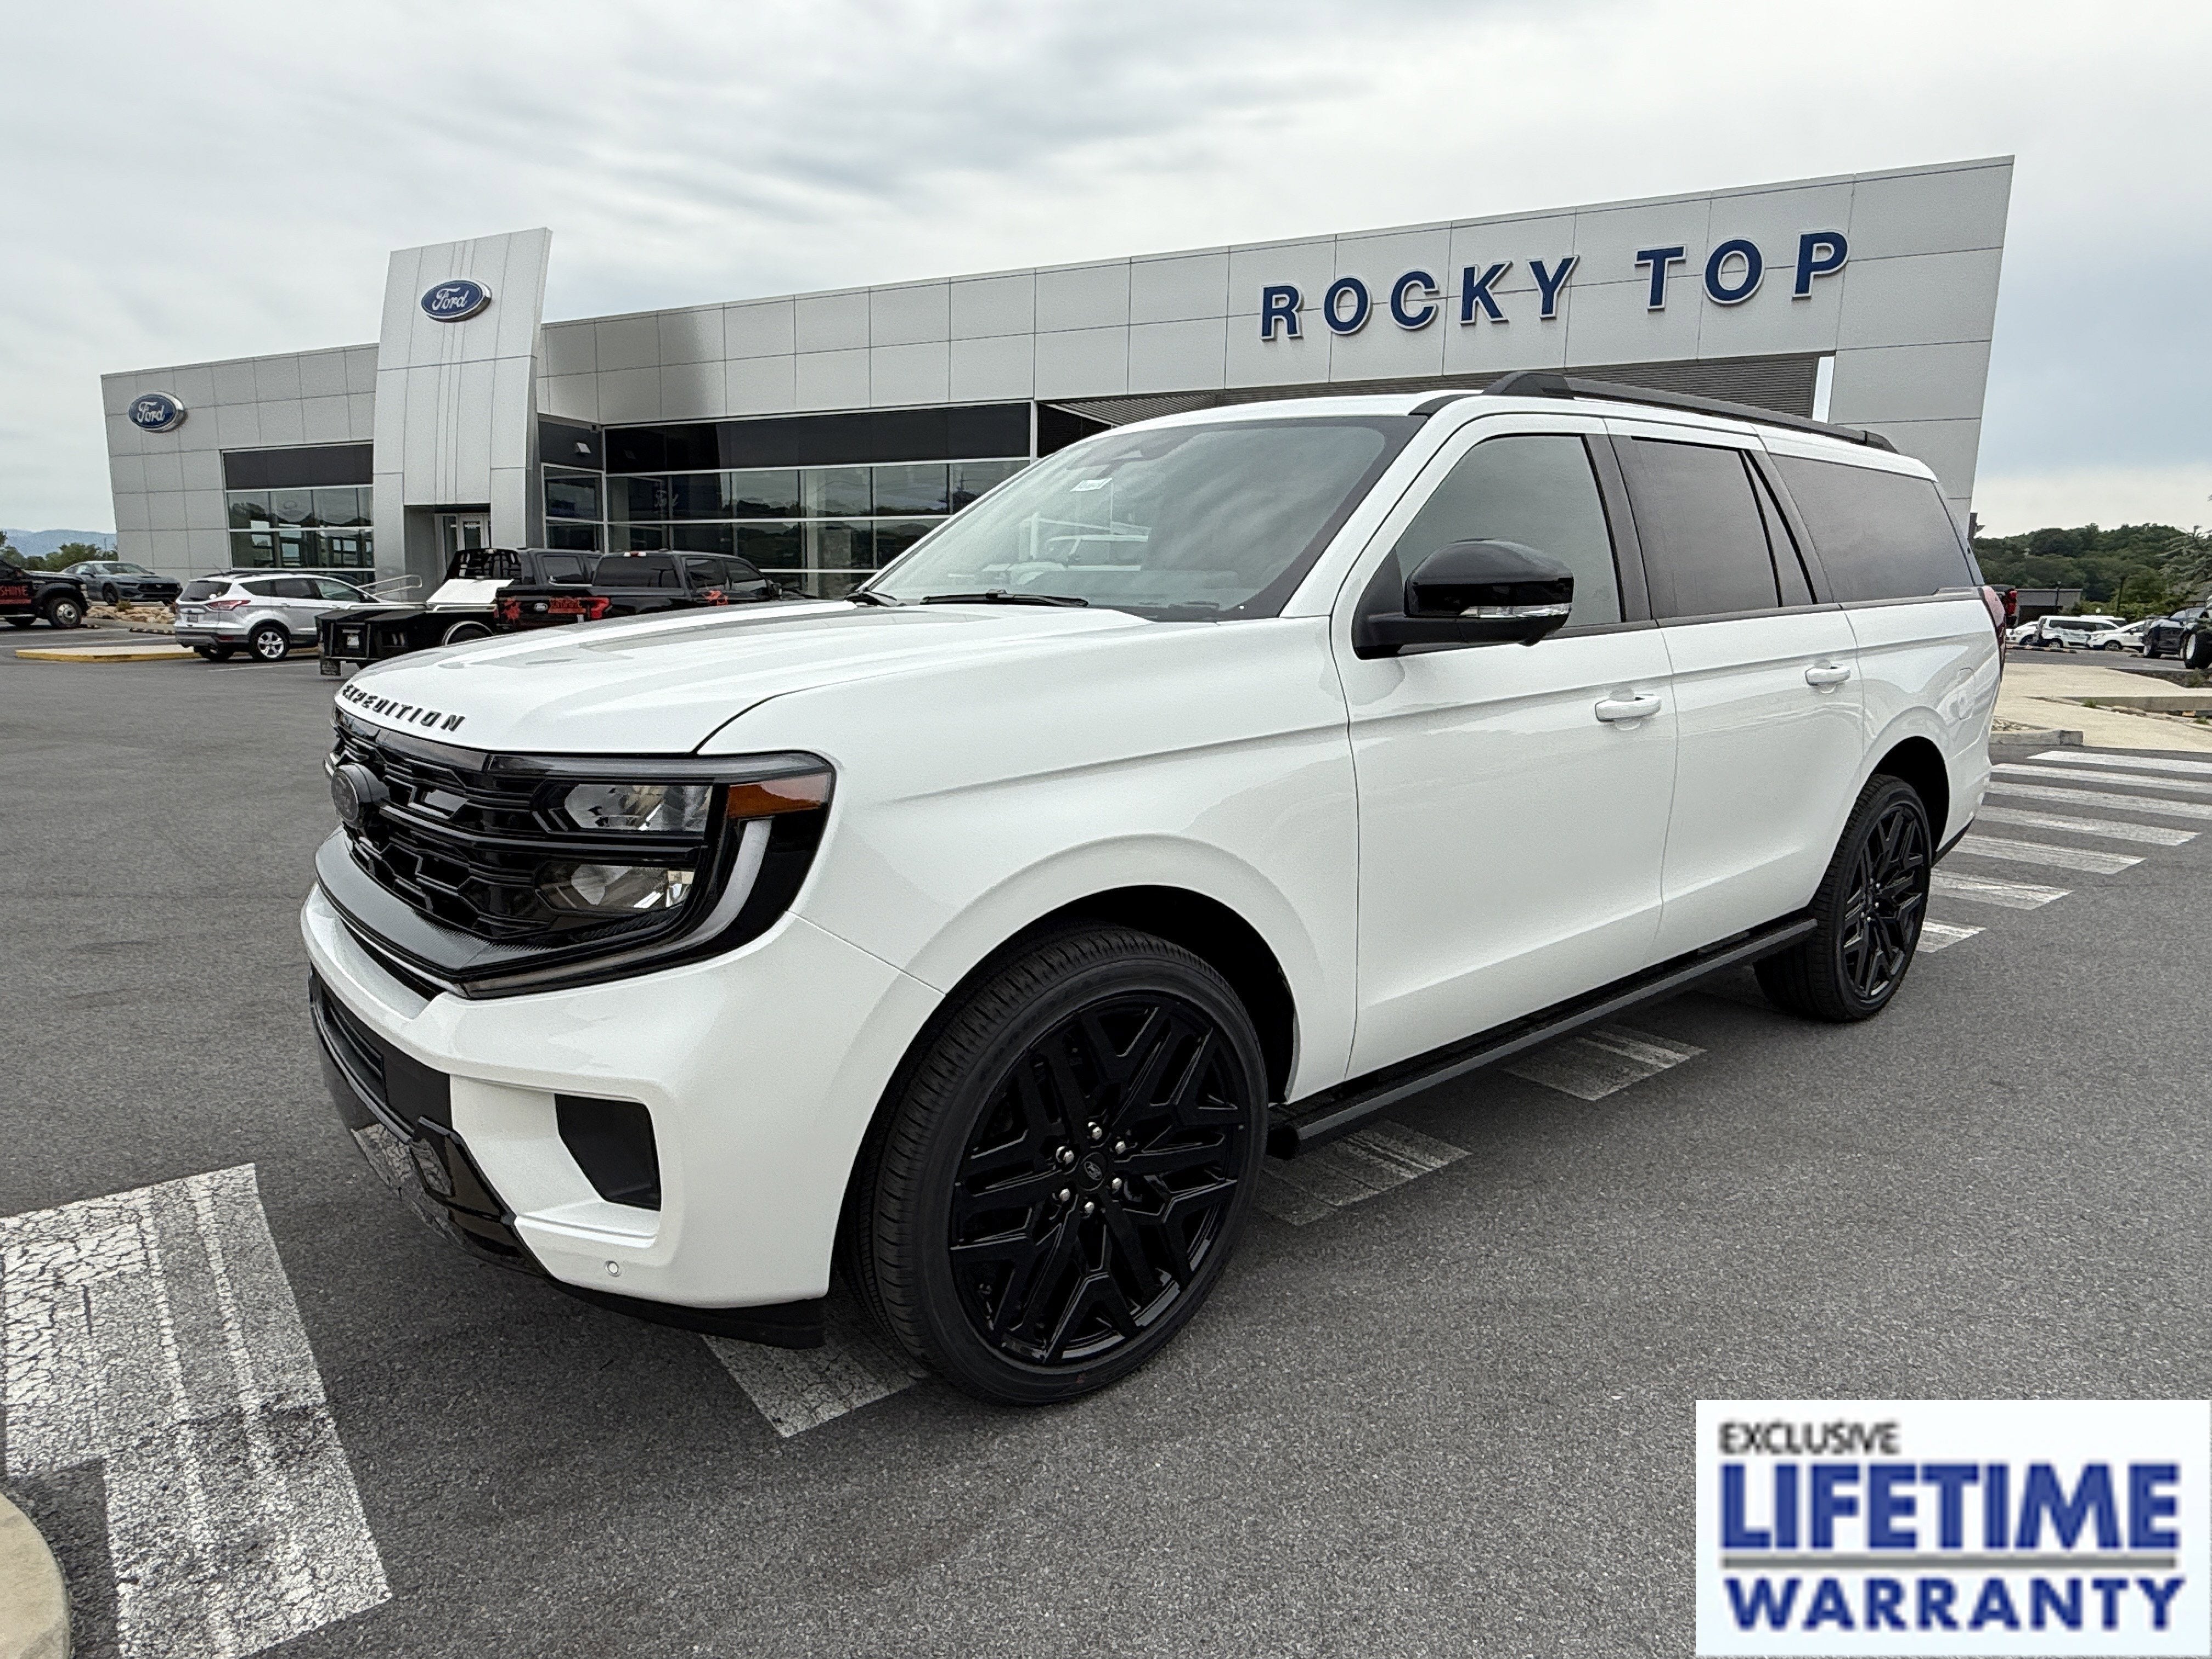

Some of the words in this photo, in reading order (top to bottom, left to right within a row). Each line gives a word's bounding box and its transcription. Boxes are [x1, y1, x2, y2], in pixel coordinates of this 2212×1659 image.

[431, 286, 470, 311] Ford
[1261, 256, 1576, 338] ROCKY
[1636, 231, 1848, 307] TOP
[137, 401, 166, 423] Ford
[342, 684, 466, 731] EXPEDITION
